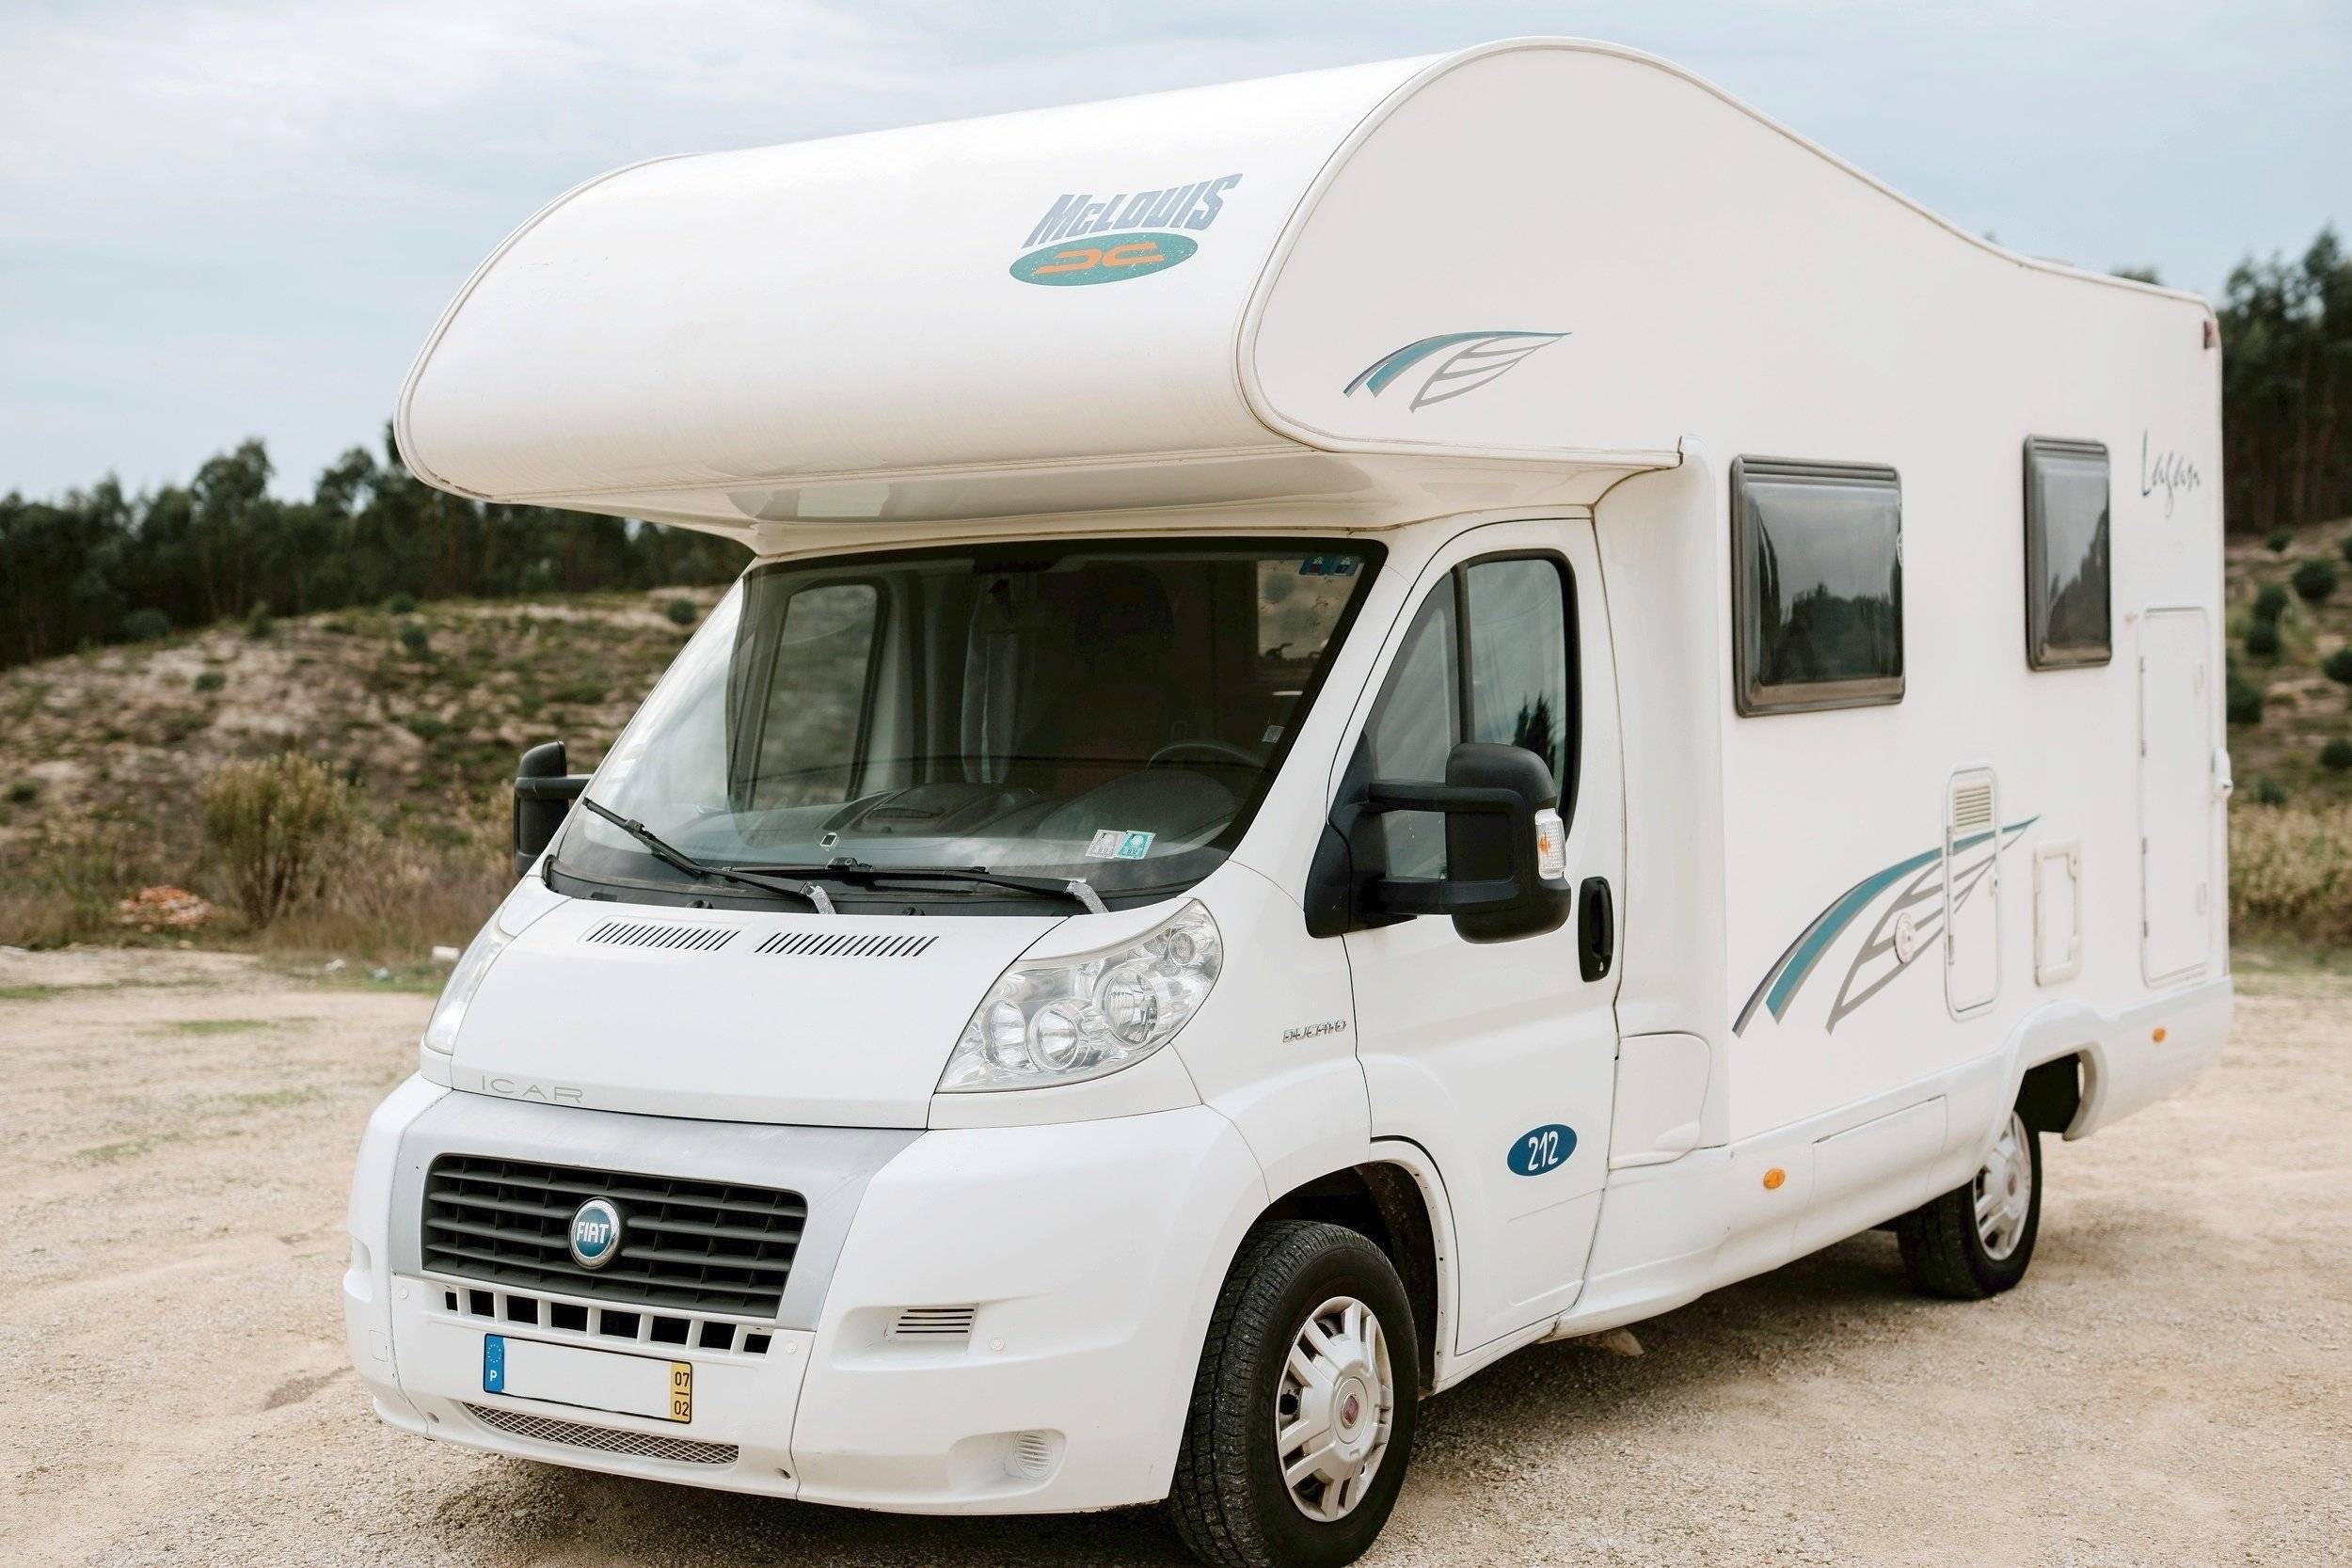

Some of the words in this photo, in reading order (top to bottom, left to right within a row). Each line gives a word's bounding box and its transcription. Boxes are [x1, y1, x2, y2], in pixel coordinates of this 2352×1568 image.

[482, 1075, 583, 1103] ICAR
[1528, 1131, 1559, 1171] 212
[576, 1221, 610, 1244] FIAT
[489, 1369, 498, 1382] P
[675, 1370, 690, 1387] 07
[674, 1400, 690, 1417] 02
